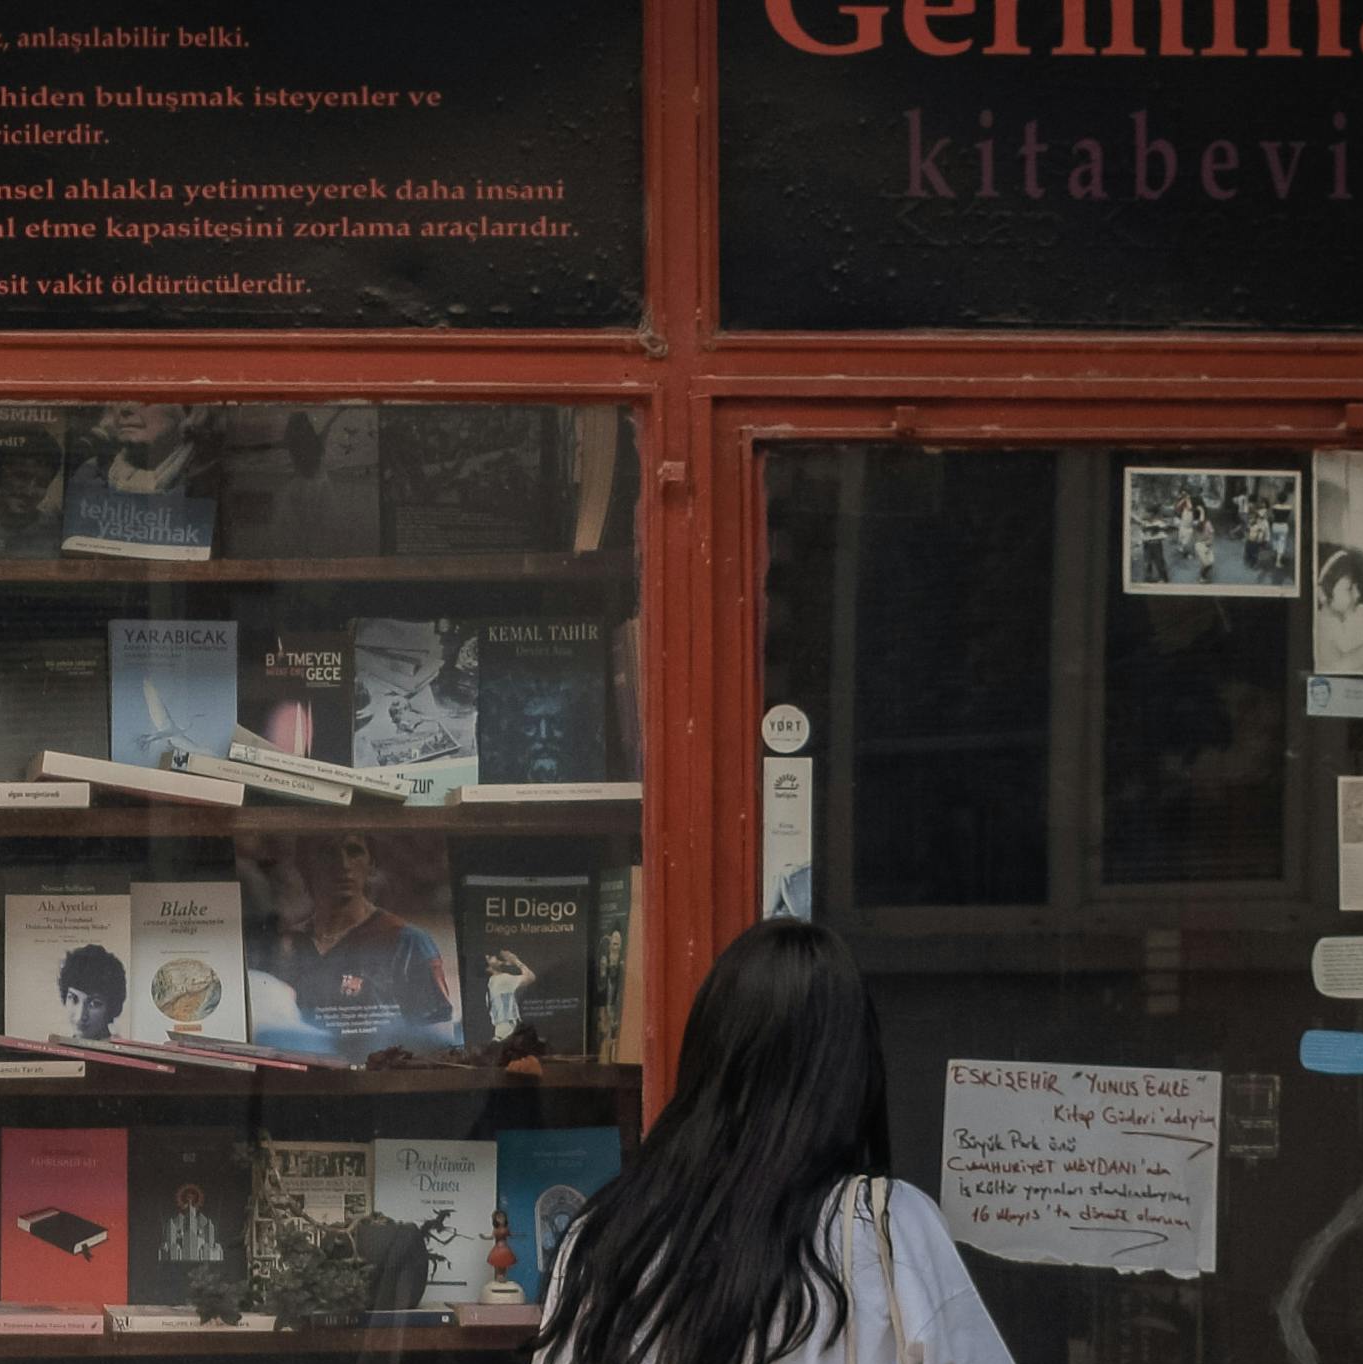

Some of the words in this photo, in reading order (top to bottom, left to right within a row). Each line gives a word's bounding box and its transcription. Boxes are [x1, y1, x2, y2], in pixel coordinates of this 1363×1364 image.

[17, 26, 170, 53] anlaşılabilir
[178, 26, 249, 48] belki.
[95, 85, 244, 113] buluşmak
[254, 85, 400, 113] isteyenler
[408, 91, 442, 107] ve
[903, 107, 1353, 201] kitabevi
[64, 177, 173, 200] ahlakla
[184, 177, 387, 206] yetinmeyerek
[395, 179, 465, 201] daha
[476, 179, 564, 201] insani
[24, 218, 97, 239] etme
[106, 216, 284, 245] kapasitesini
[293, 216, 412, 238] zorlama
[420, 215, 579, 242] araçlarıdır.
[36, 272, 104, 295] vakit
[111, 272, 312, 295] öldürücülerdir.
[79, 499, 172, 528] tehlikeli
[96, 518, 200, 545] yaşamak
[487, 624, 543, 643] KEMAL
[547, 621, 599, 641] TAHİR
[306, 666, 342, 682] GECE
[159, 901, 209, 918] Blake
[485, 897, 507, 917] El
[513, 897, 577, 923] Diego
[485, 922, 518, 936] Diego
